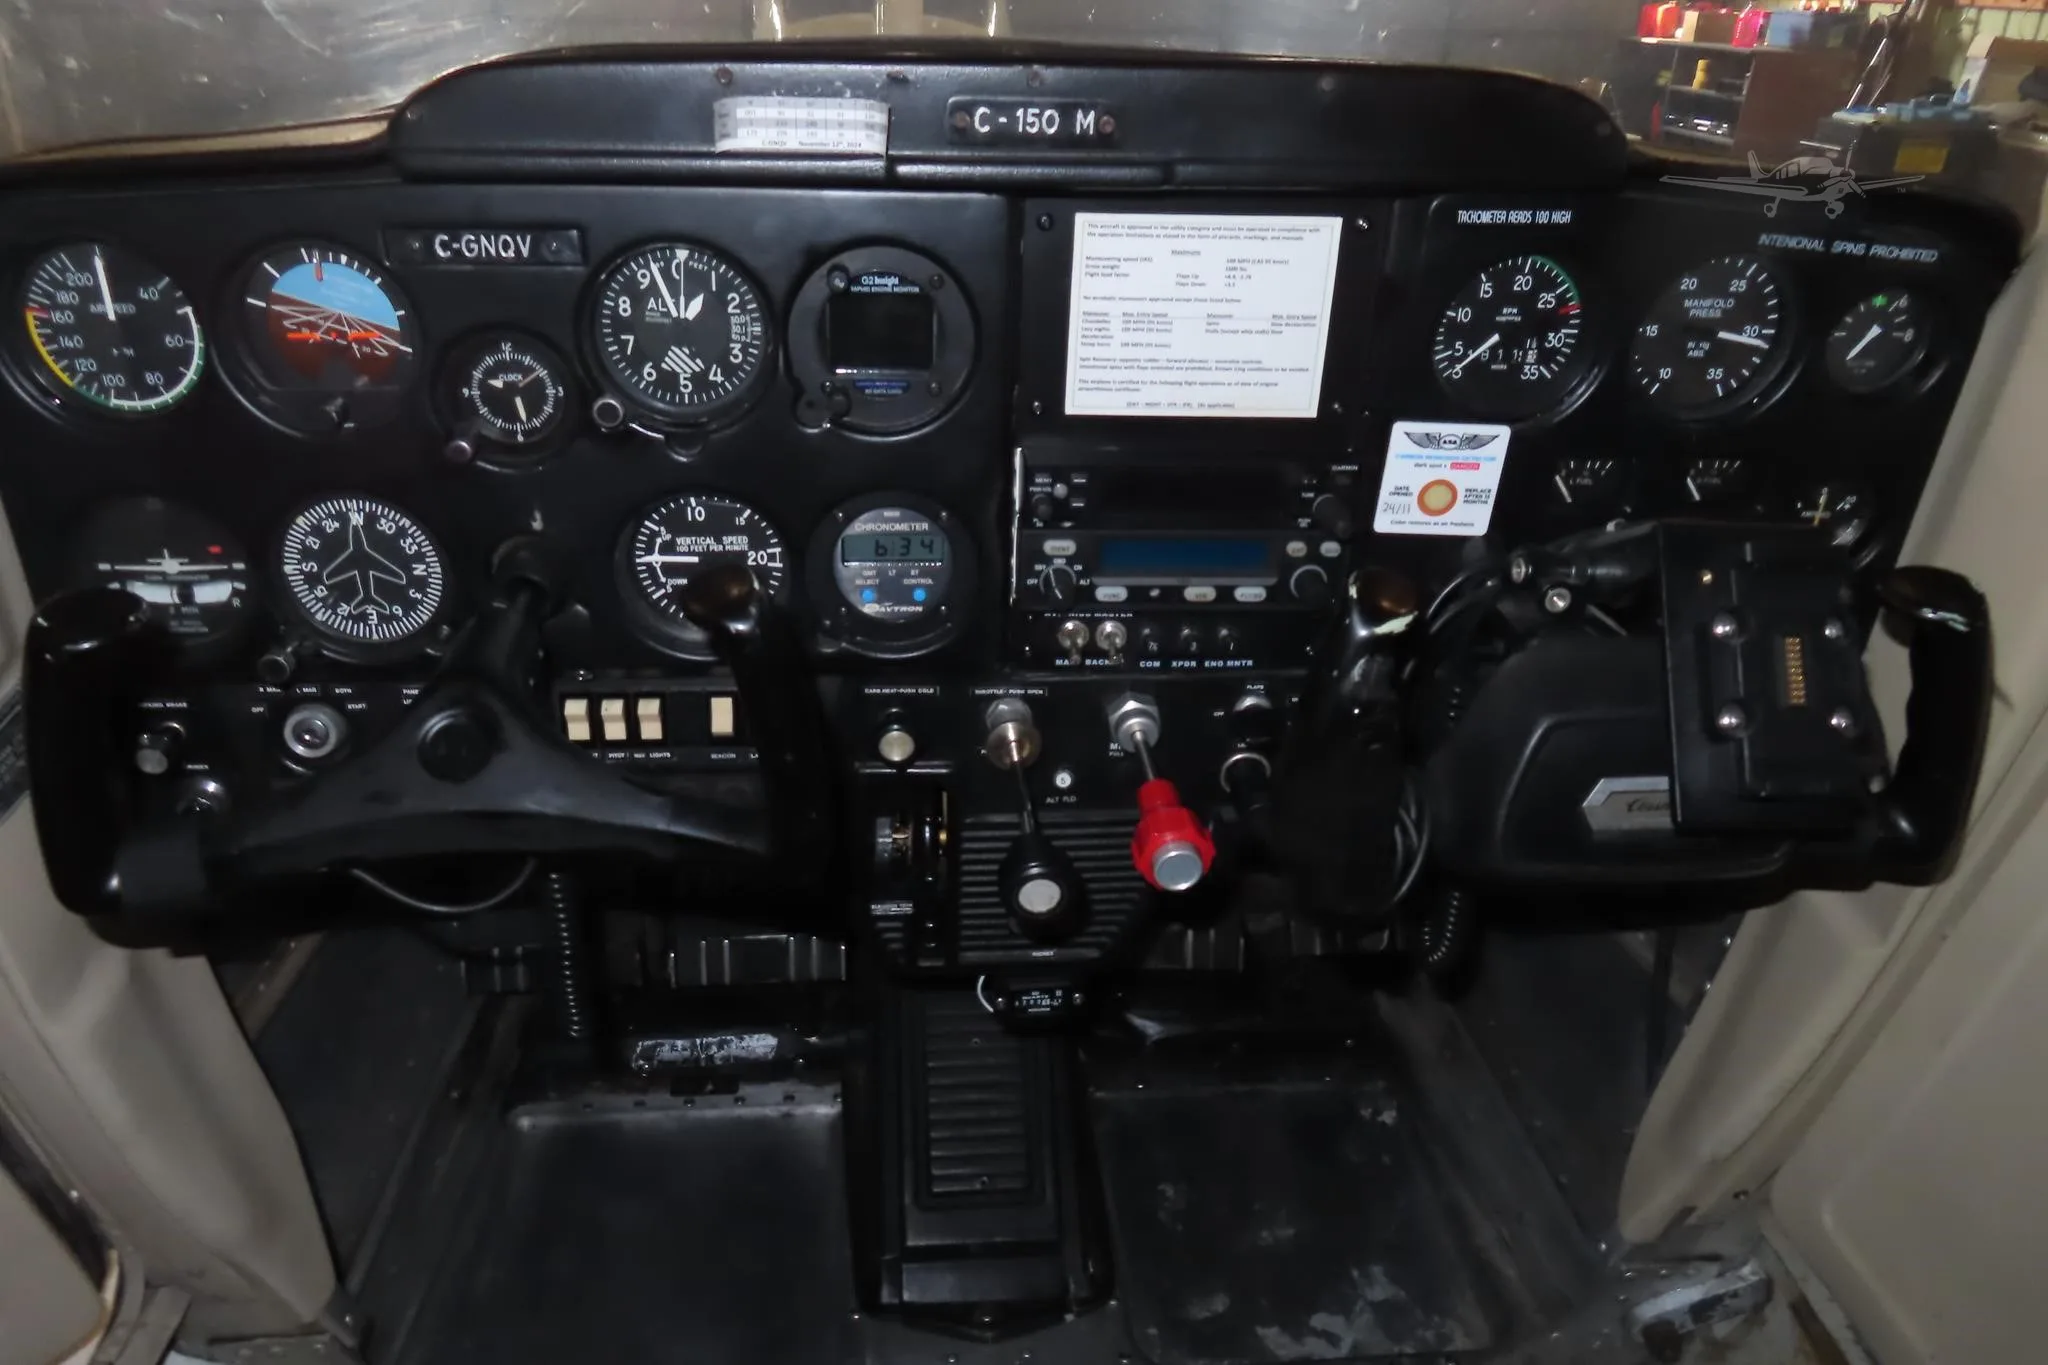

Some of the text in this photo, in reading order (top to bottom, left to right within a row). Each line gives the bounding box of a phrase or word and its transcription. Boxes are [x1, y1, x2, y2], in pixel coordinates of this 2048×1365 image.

[1076, 110, 1094, 136] M
[1457, 210, 1572, 224] TACHOMETER READS 100 HIGH
[434, 233, 531, 258] C-GNQV
[1831, 240, 1866, 256] SPINS
[66, 272, 94, 287] 200
[636, 269, 651, 290] 9
[1513, 275, 1532, 291] 20
[1680, 278, 1698, 290] 20
[1729, 279, 1747, 292] 25
[56, 290, 79, 305] 180
[139, 287, 159, 301] 40
[1479, 283, 1492, 299] 15
[618, 296, 632, 317] 8
[727, 293, 741, 314] 2
[1537, 293, 1556, 309] 25
[1684, 299, 1734, 308] MANIFOLD
[50, 308, 75, 325] 160
[1457, 307, 1471, 322] 10
[1689, 309, 1722, 318] PRESS
[1646, 325, 1659, 337] 15
[1742, 325, 1759, 337] 30
[59, 338, 83, 350] 140
[165, 334, 184, 348] 60
[620, 335, 635, 355] 7
[1544, 332, 1565, 348] 30
[729, 343, 742, 363] 3
[1454, 341, 1464, 356] 5
[74, 358, 97, 372] 120
[643, 362, 657, 381] 6
[1520, 365, 1539, 380] 35
[102, 374, 126, 387] 100
[145, 371, 164, 385] 80
[708, 364, 724, 384] 4
[1659, 367, 1672, 379] 10
[1706, 368, 1724, 379] 35
[679, 373, 692, 393] 5
[462, 388, 469, 397] 9
[687, 506, 705, 521] 10
[735, 516, 746, 526] 15
[322, 518, 340, 533] 24
[376, 517, 395, 534] 30
[854, 522, 929, 532] CHRONOMETER
[305, 535, 320, 550] 21
[400, 536, 419, 554] 33
[675, 535, 748, 545] VERTICAL SPEED
[690, 544, 708, 552] FEET
[709, 544, 724, 552] PER
[725, 543, 749, 551] MINUTE
[747, 550, 768, 566] 20
[302, 562, 318, 573] S
[412, 563, 428, 576] N
[667, 578, 688, 586] DOWN
[855, 578, 880, 586] SELECT
[232, 596, 241, 609] R
[368, 609, 378, 624] E
[1139, 660, 1161, 668] COM
[1171, 660, 1197, 668] XPDR
